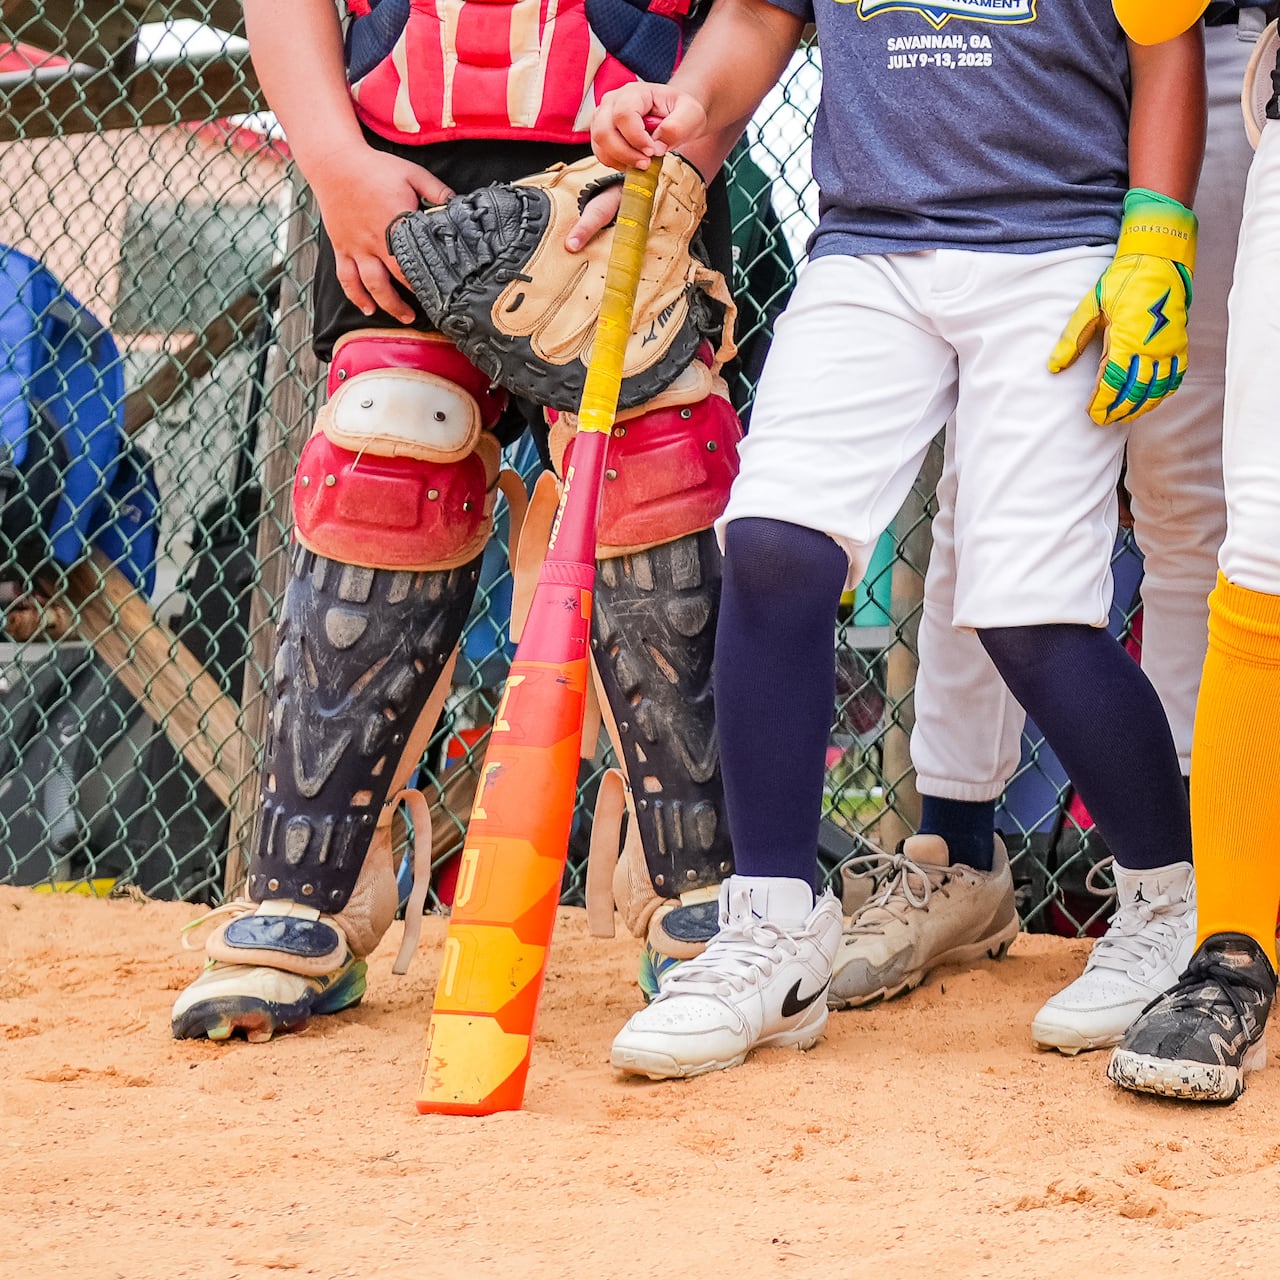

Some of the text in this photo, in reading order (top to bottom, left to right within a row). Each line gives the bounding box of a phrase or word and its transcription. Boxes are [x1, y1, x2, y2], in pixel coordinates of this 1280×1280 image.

[887, 34, 992, 51] SAVANNAH, GA
[887, 52, 993, 70] JULY 9-13, 2025
